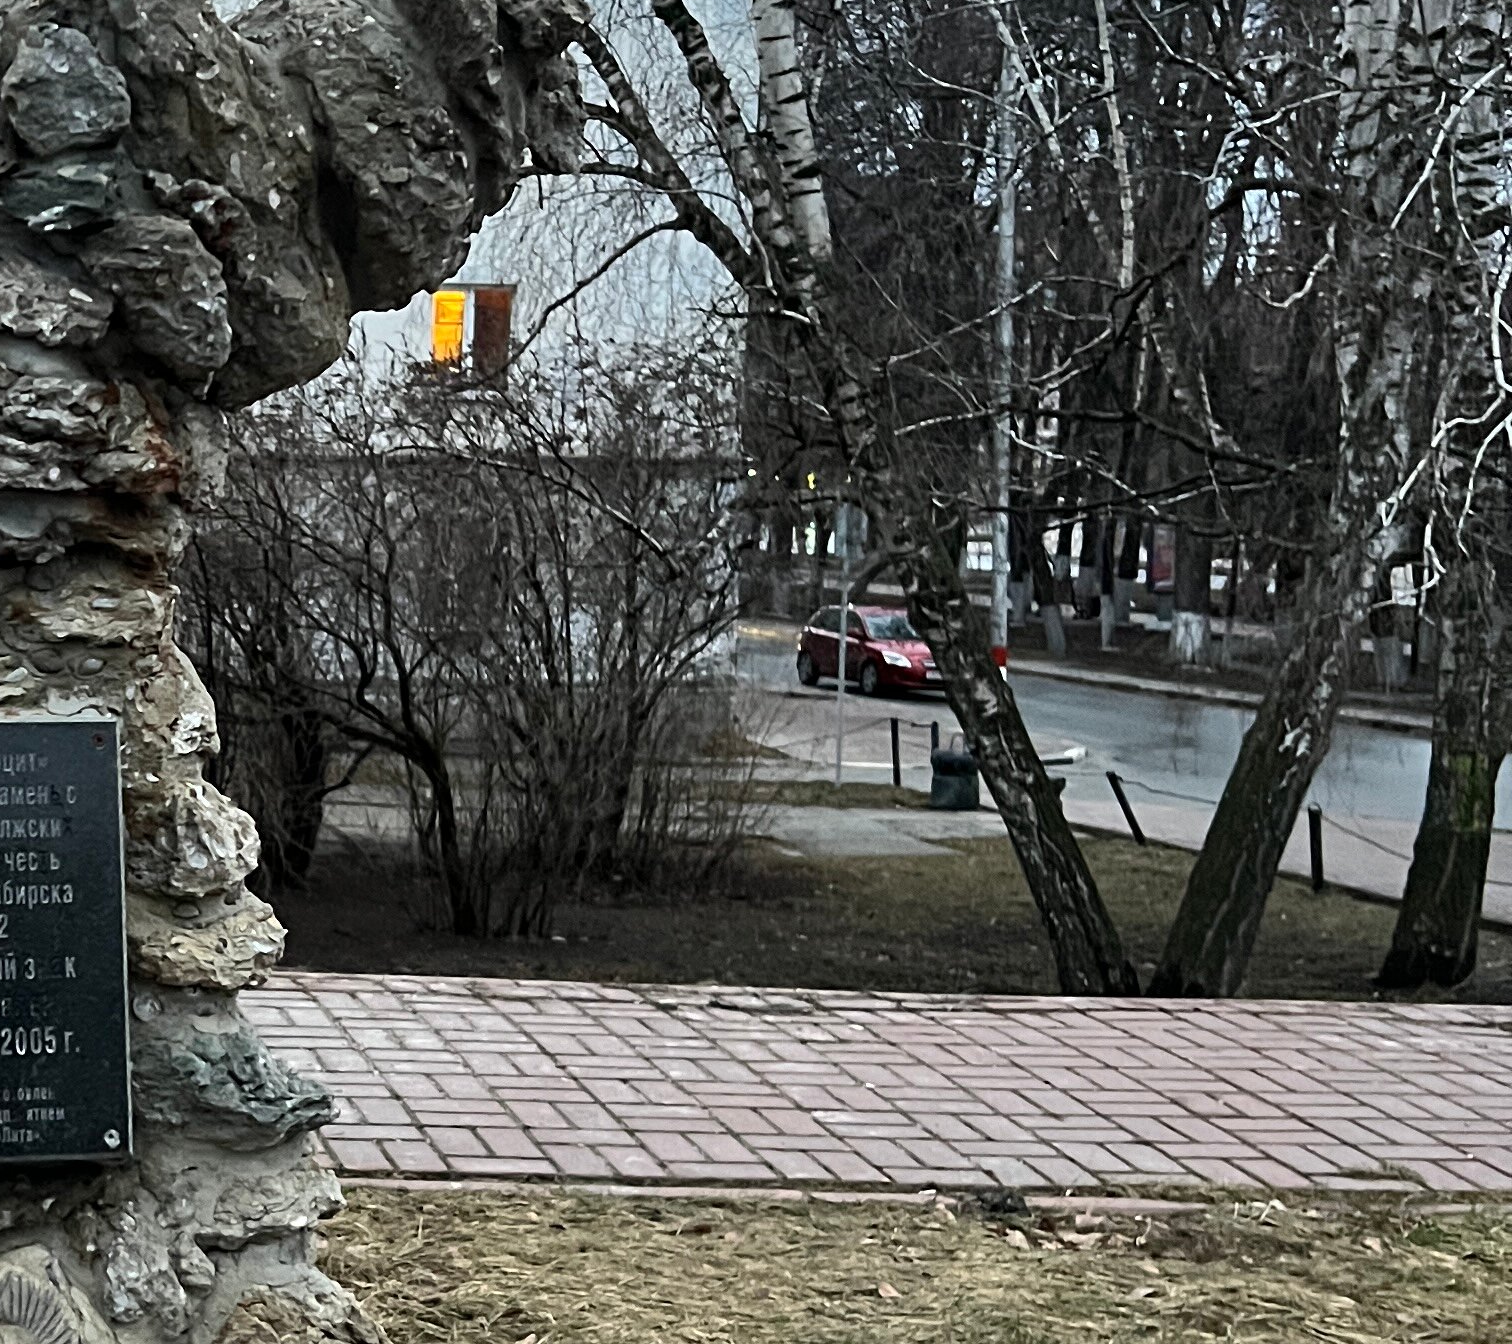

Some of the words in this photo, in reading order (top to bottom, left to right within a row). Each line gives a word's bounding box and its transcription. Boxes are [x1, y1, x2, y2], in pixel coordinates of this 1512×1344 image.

[65, 785, 78, 806] с
[0, 1025, 57, 1056] 2005
[63, 1030, 81, 1054] г.
